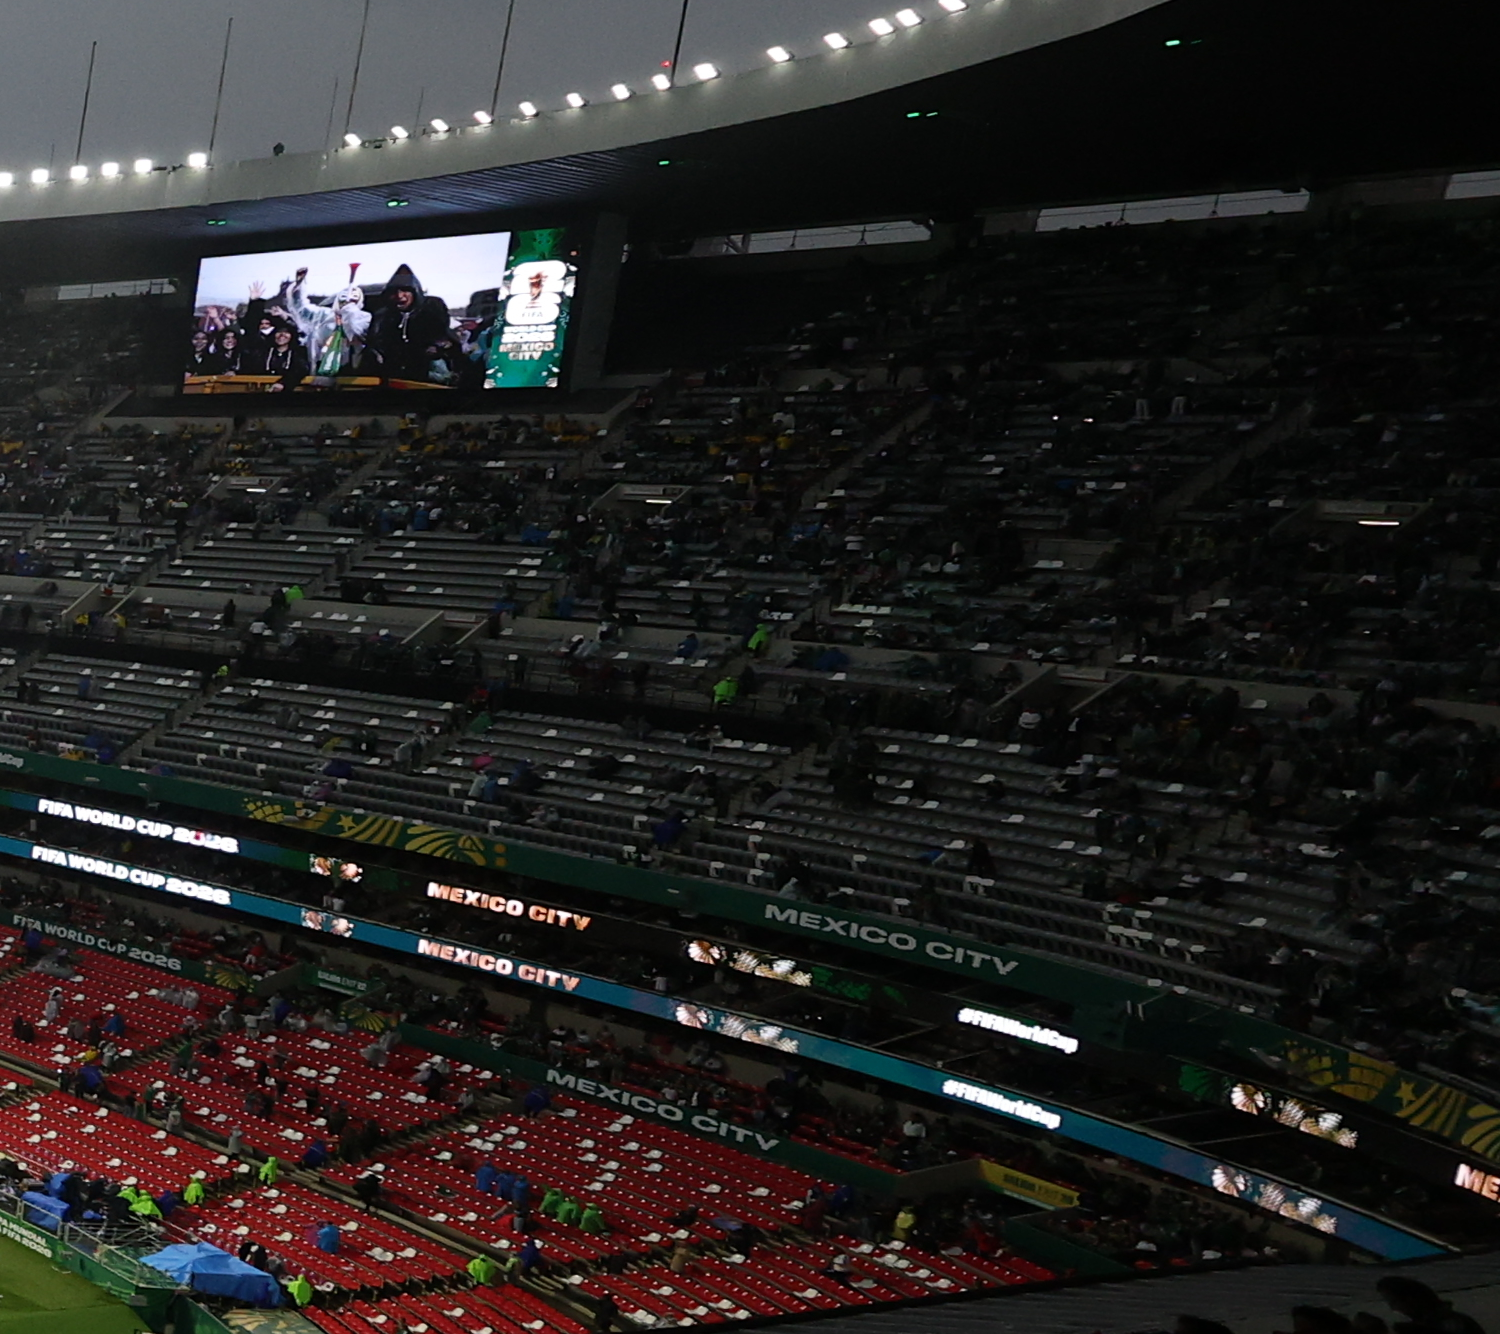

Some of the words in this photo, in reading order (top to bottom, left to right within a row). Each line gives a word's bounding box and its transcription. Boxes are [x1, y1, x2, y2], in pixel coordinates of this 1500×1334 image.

[500, 342, 554, 353] MEXICO
[508, 351, 543, 361] CITY
[38, 799, 75, 819] FIFA
[75, 806, 136, 831] WORLD
[136, 818, 173, 838] CUP
[173, 827, 239, 854] 2026
[32, 845, 68, 866] FIFA
[69, 853, 129, 880] WORLD
[129, 868, 165, 888] CUP
[165, 879, 231, 905] 2026
[427, 881, 524, 916] MEXICO
[528, 905, 592, 931] CITY
[43, 922, 96, 946] WORLD
[97, 938, 127, 954] CUP
[127, 947, 183, 971] 2026
[417, 939, 514, 975] MEXICO
[517, 964, 581, 991] CITY
[764, 904, 917, 951] MEXICO
[925, 941, 1019, 976] CITY
[958, 1007, 1078, 1054] #FIFAWorldCup
[546, 1069, 684, 1121] MEXICO
[691, 1115, 780, 1151] CITY
[943, 1079, 1061, 1129] #FIFAWorldCup
[1454, 1163, 1500, 1203] ME
